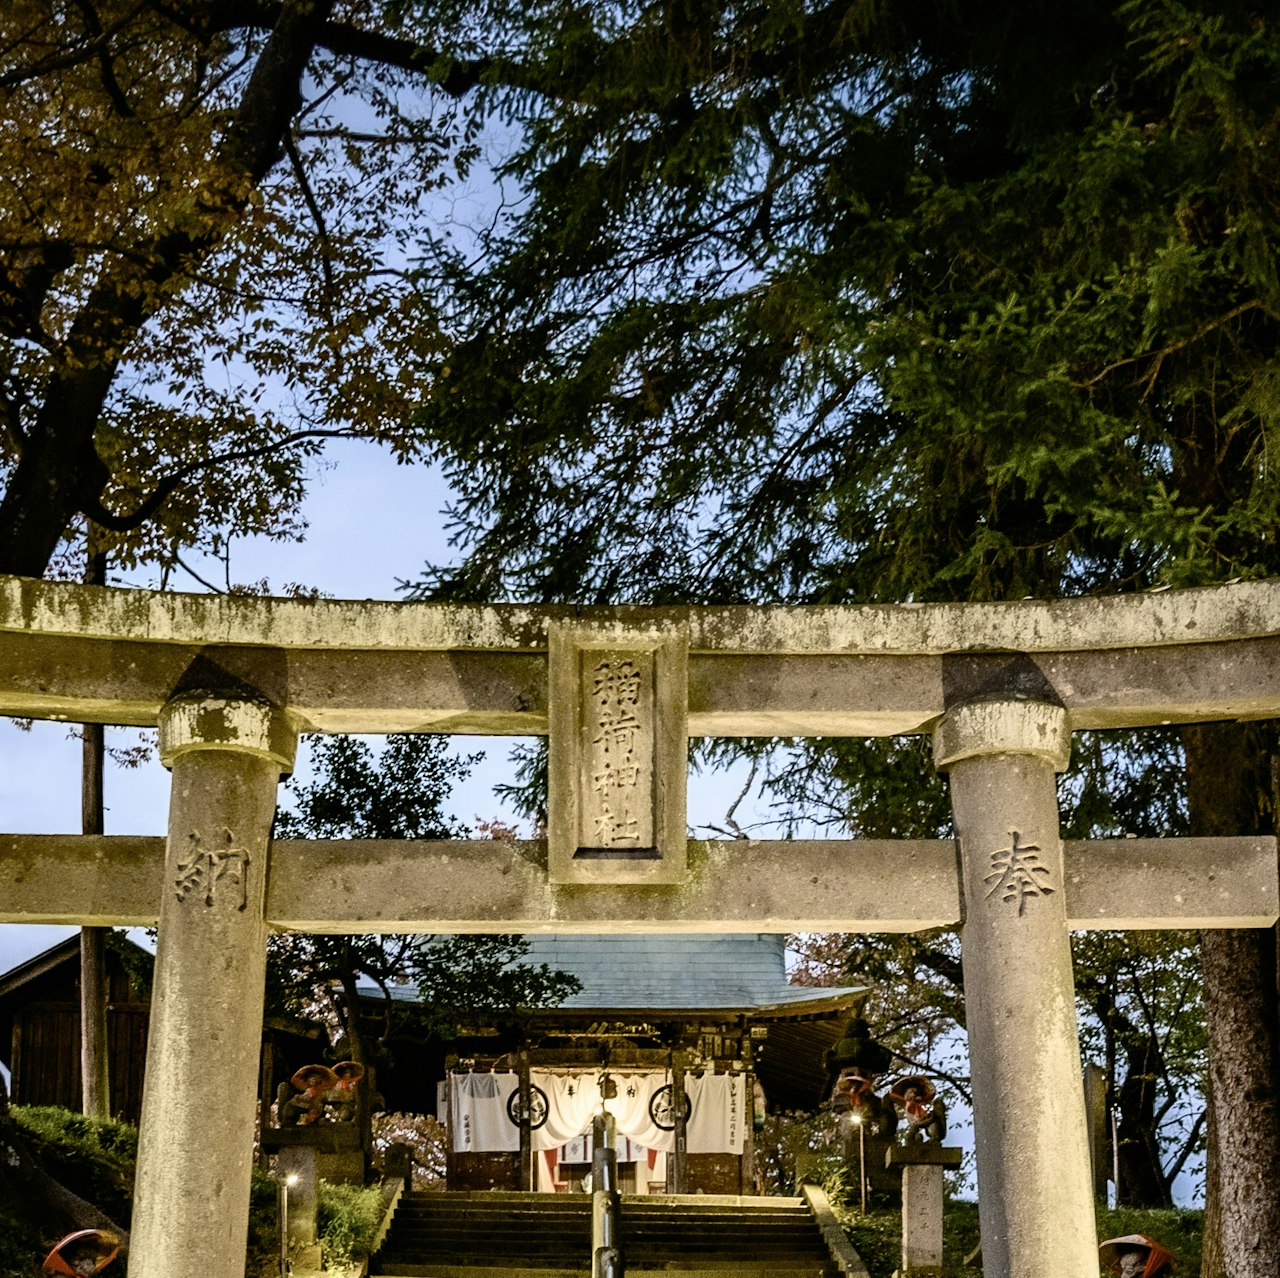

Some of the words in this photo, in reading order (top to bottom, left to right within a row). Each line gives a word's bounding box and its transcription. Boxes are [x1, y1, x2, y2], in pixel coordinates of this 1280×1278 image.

[592, 660, 641, 847] 稲荷神社
[175, 827, 251, 912] 納
[983, 828, 1056, 918] 奉
[567, 1084, 575, 1099] 奉
[626, 1085, 636, 1098] 納
